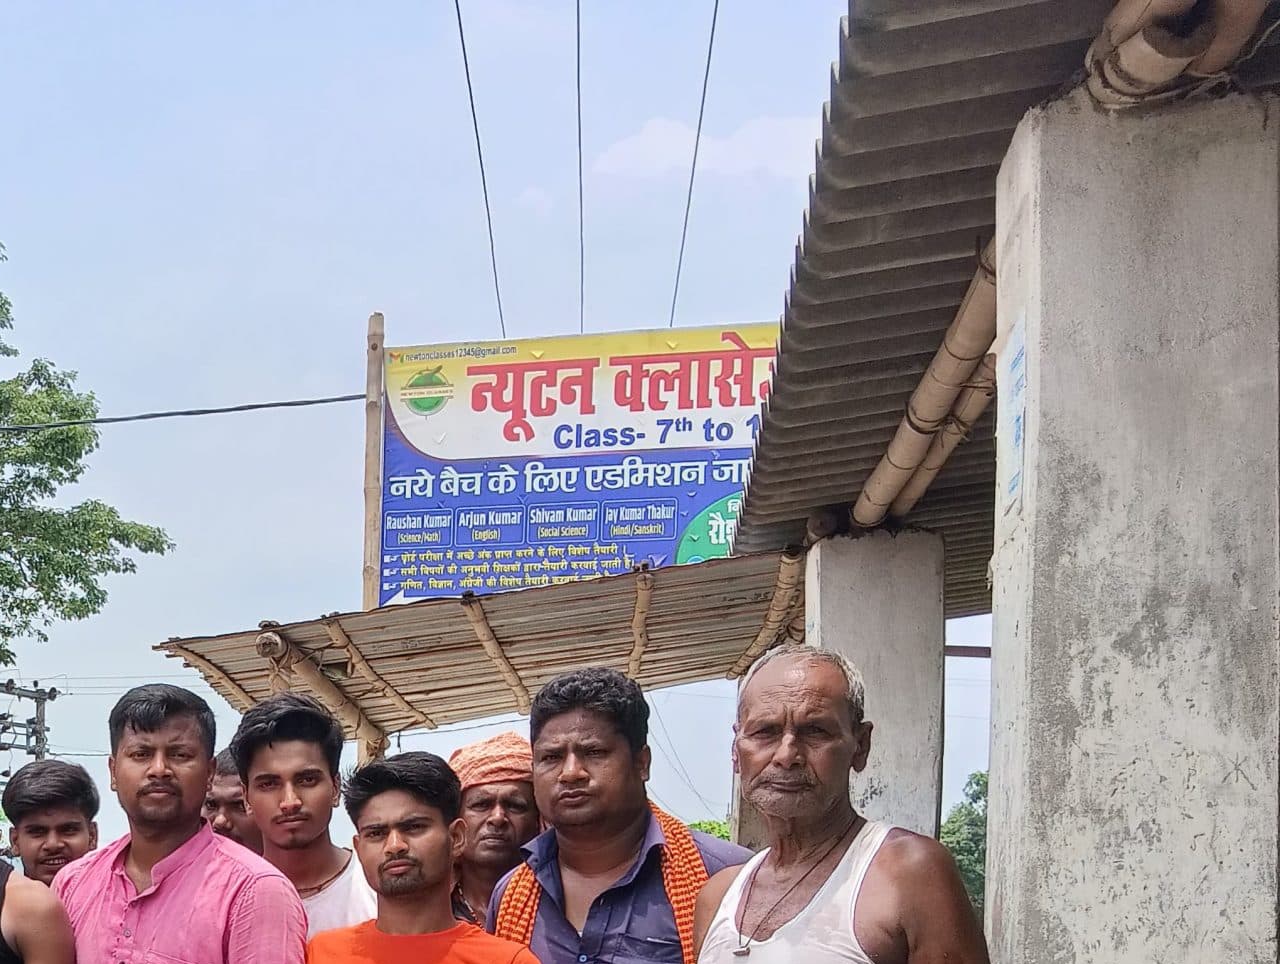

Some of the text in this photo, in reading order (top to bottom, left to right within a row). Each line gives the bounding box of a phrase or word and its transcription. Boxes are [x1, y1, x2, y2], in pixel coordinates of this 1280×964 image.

[405, 347, 517, 362] newtonclasses12345@gmail.com
[467, 331, 776, 442] न्यूटन क्लासे
[554, 416, 733, 449] Class- 7th to
[389, 456, 707, 498] नये बैच के लिए एडमिशन
[386, 514, 451, 529] Raushan Kumar
[459, 511, 522, 528] Arjun Kumar
[530, 507, 596, 524] Shivam Kumar
[606, 505, 675, 524] Jay Kumar Thakur
[472, 528, 500, 542] (English)
[538, 524, 588, 538] (Social Science)
[548, 545, 564, 557] लिए
